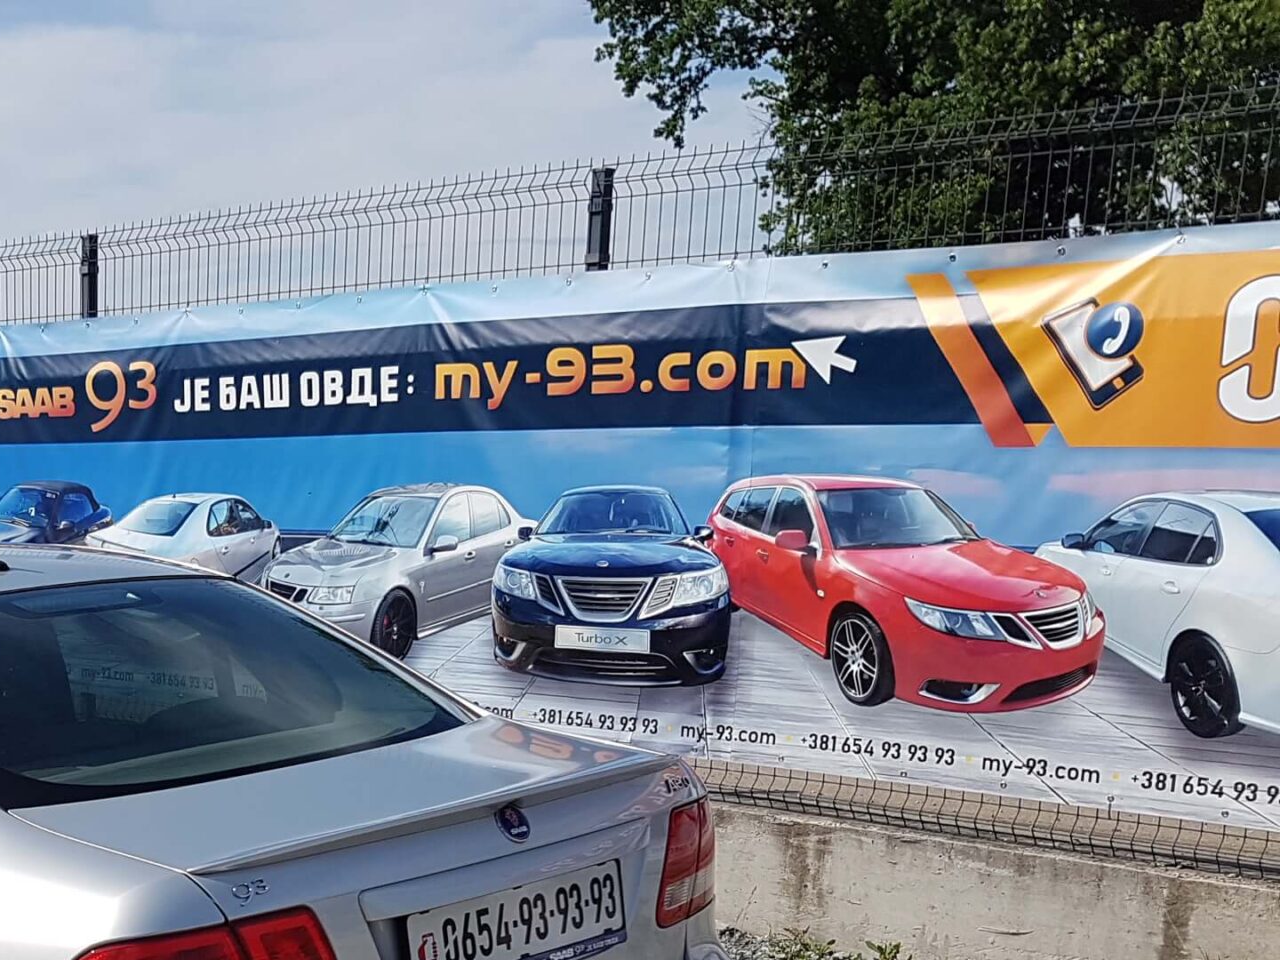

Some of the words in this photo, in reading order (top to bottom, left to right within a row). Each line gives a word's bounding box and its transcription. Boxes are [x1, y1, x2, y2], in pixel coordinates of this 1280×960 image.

[84, 360, 157, 433] 93
[173, 378, 211, 413] ЈЕ
[219, 373, 290, 411] БАШ
[434, 343, 808, 410] my-93.com
[574, 631, 612, 646] Turbo
[614, 635, 628, 646] X
[598, 714, 614, 730] 93
[620, 716, 637, 732] 93
[642, 718, 659, 734] 93
[680, 725, 776, 746] my-93.com
[881, 741, 901, 759] 93
[908, 744, 928, 762] 93
[934, 747, 955, 766] 93
[982, 756, 1100, 784] my-93.com
[1233, 781, 1258, 802] 93
[1267, 785, 1280, 804] 9
[231, 878, 270, 907] 93
